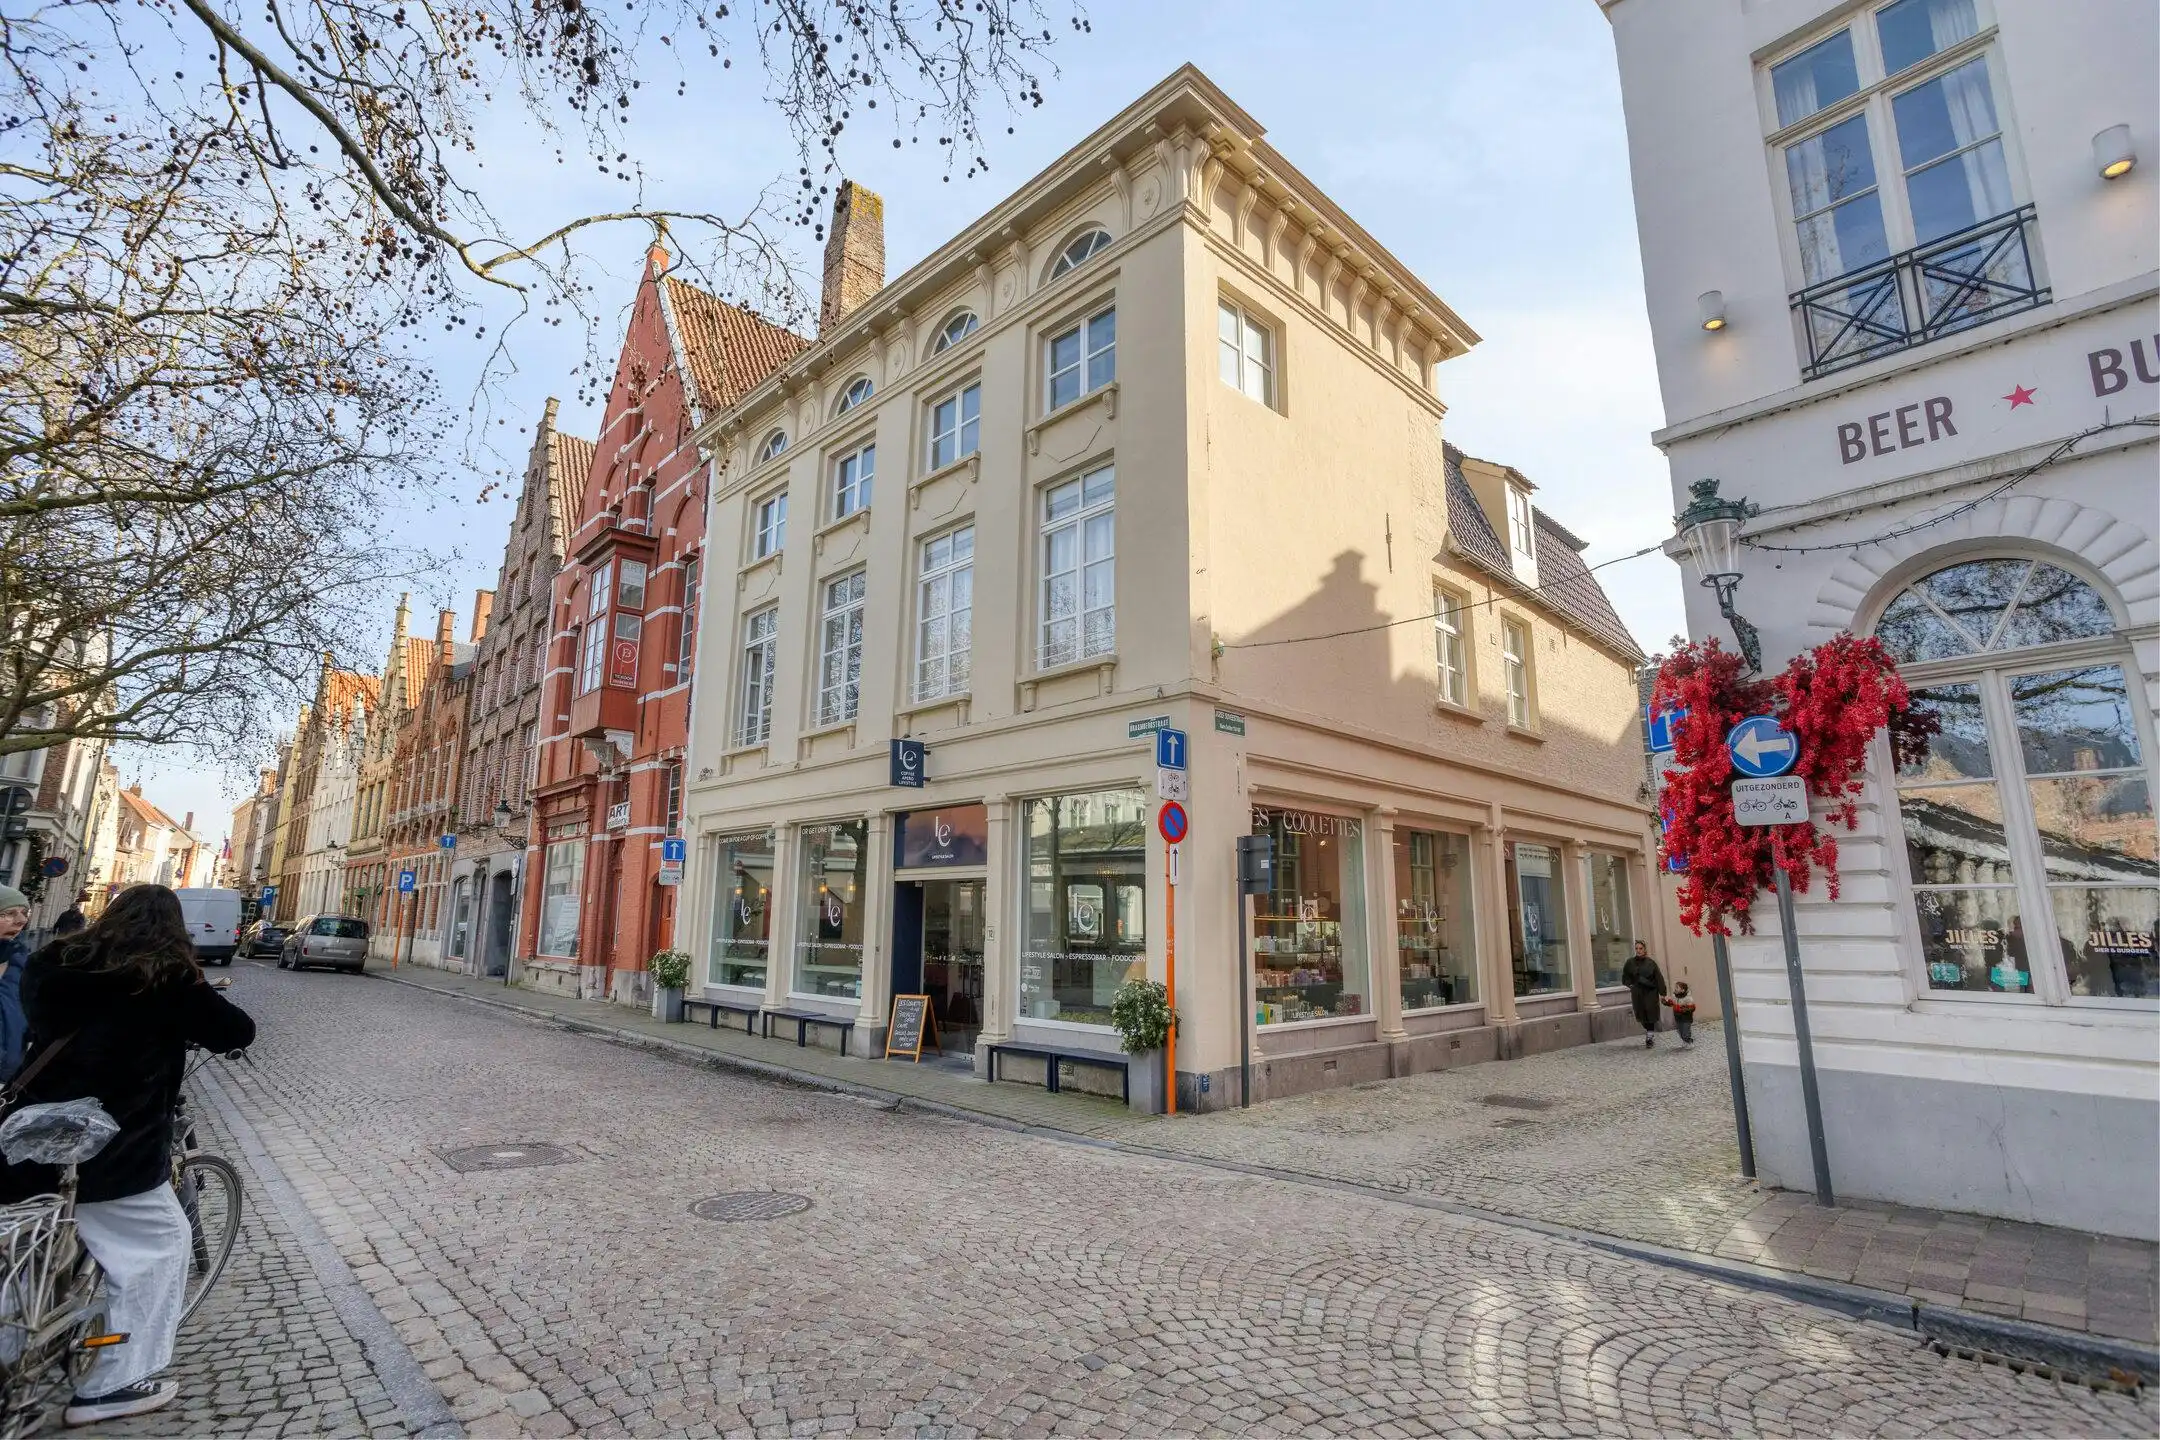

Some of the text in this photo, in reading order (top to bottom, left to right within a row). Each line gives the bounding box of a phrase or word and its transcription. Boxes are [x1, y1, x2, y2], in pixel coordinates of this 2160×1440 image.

[1837, 396, 1958, 465] BEER
[1735, 781, 1800, 792] UITGEZONDERD
[609, 804, 627, 819] ART
[1283, 811, 1361, 838] COQUETTES
[401, 874, 412, 888] P
[1945, 930, 1999, 944] JILLES
[2088, 931, 2152, 948] JILLES
[1022, 951, 1046, 959] LIFESTYLE
[1069, 953, 1107, 961] ESPRESSOBAR
